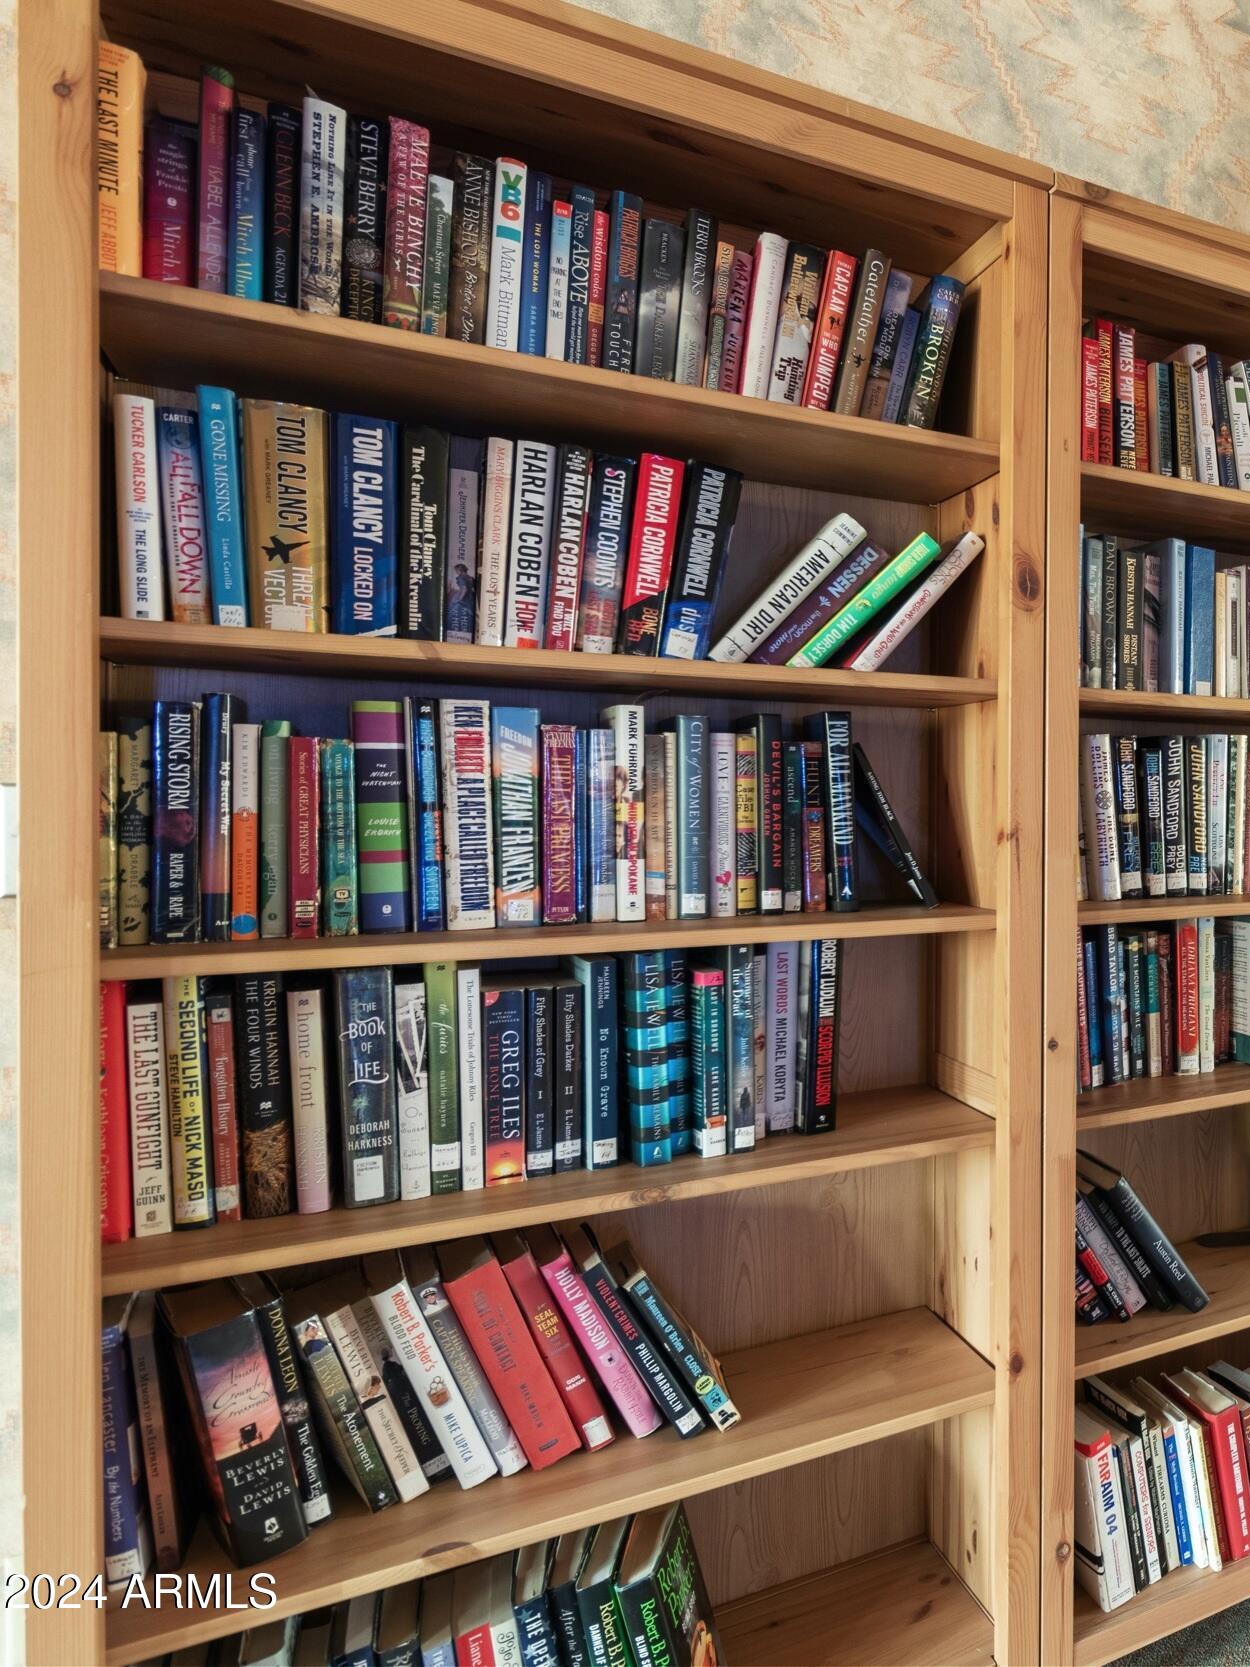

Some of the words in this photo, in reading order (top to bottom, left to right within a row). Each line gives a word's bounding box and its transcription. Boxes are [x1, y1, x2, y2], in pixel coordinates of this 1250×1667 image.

[98, 97, 118, 137] LAST
[98, 139, 119, 195] MINUTE
[311, 111, 322, 182] STEPHEN
[360, 121, 378, 174] STEVE
[208, 165, 224, 209] ISABEL
[410, 137, 430, 213] MAEVE
[465, 160, 484, 204] ANNE
[358, 179, 376, 240] BERRY
[206, 214, 222, 283] ALLENDE
[309, 203, 321, 274] AMBROSE
[406, 213, 425, 289] BINCHY
[461, 204, 481, 267] BISHOP
[274, 247, 286, 289] AGENDA
[501, 246, 515, 285] Mark
[570, 240, 589, 305] ABOVE
[831, 266, 850, 314] CAPLAN
[496, 287, 514, 348] Bittman
[609, 324, 622, 367] TOUCH
[622, 339, 631, 375] FIRE
[916, 322, 943, 400] BROKEN
[1119, 331, 1134, 373] JAMES
[812, 349, 838, 400] JUMPED
[1098, 358, 1112, 403] PATTERSON
[130, 406, 145, 449] TUCKER
[162, 413, 194, 424] CARTER
[1085, 386, 1098, 429] PATTERSON
[1119, 375, 1135, 450] PATTERSON
[210, 420, 227, 460] GONE
[276, 416, 306, 455] TOM
[352, 428, 382, 466] TOM
[132, 452, 146, 502] CARLSON
[213, 464, 231, 522] MISSING
[277, 460, 308, 534] CLANCY
[521, 447, 547, 527] HARLAN
[600, 467, 626, 527] STEPHEN
[645, 463, 674, 524] PATRICIA
[696, 467, 725, 526] PATRICIA
[352, 471, 383, 544] CLANCY
[559, 469, 585, 537] HARLAN
[136, 550, 147, 574] LONG
[177, 526, 202, 594] DOWN
[353, 548, 373, 599] LOCKED
[515, 531, 543, 598] COBEN
[555, 540, 580, 597] COBEN
[594, 529, 619, 589] COONTS
[635, 526, 665, 597] CORNWELL
[683, 527, 716, 597] CORNWELL
[828, 547, 879, 599] DESSEN
[1106, 541, 1117, 572] DAN
[136, 576, 148, 602] SLIDE
[778, 549, 830, 615] AMERICAN
[1106, 576, 1115, 624] BROWN
[353, 601, 373, 620] ON
[515, 600, 538, 634] HOME
[742, 607, 776, 642] DIRT
[810, 631, 841, 662] DORSEY
[167, 713, 191, 760] RISING
[454, 706, 483, 728] KEN
[628, 710, 638, 740] MARK
[690, 721, 702, 754] CITY
[829, 720, 848, 751] FOR
[628, 743, 638, 792] FUHRMAN
[771, 741, 780, 799] DEVIL'S
[1120, 739, 1131, 762] JOHN
[1168, 740, 1181, 776] JOHN
[1190, 745, 1206, 780] JOHN
[167, 762, 190, 810] STORM
[457, 788, 486, 823] PLACE
[690, 776, 702, 829] WOMEN
[1121, 764, 1135, 810] SANDFORD
[1147, 775, 1160, 818] SANDFORD
[1166, 779, 1181, 839] SANDFORD
[1192, 783, 1207, 853] SANDFORD
[459, 824, 488, 860] CALLED
[772, 803, 781, 868] BARGAIN
[1166, 845, 1176, 869] PREY
[502, 827, 535, 896] FRANZEN
[460, 862, 490, 912] FREEDOM
[821, 940, 836, 978] ROBERT
[1108, 927, 1116, 953] BRAD
[644, 964, 658, 995] LISA
[777, 952, 788, 976] LAST
[1108, 954, 1117, 997] TAYLOR
[244, 980, 258, 1001] THE
[263, 980, 276, 1022] KRISTIN
[361, 1001, 376, 1012] THE
[535, 997, 545, 1016] Fifty
[565, 993, 574, 1012] Fifty
[776, 979, 788, 1020] WORDS
[819, 979, 835, 1017] LUDLUM
[132, 1011, 158, 1044] THE
[179, 1001, 198, 1062] SECOND
[246, 1008, 260, 1043] FOUR
[297, 1010, 314, 1058] home
[348, 1021, 386, 1039] BOOK
[536, 1018, 545, 1047] Shades
[565, 1014, 574, 1042] Shades
[600, 1028, 608, 1042] No
[645, 1002, 660, 1050] JEWELL
[775, 1020, 787, 1063] MICHAEL
[135, 1048, 160, 1086] LAST
[249, 1048, 262, 1089] WINDS
[265, 1031, 280, 1086] HANNAH
[354, 1060, 381, 1079] LIFE
[360, 1042, 373, 1054] OF
[501, 1030, 519, 1089] GREG
[565, 1043, 574, 1072] Darker
[600, 1048, 610, 1082] Known
[169, 1054, 178, 1086] STEVE
[182, 1065, 199, 1099] LIFE
[299, 1066, 316, 1110] front
[774, 1065, 786, 1103] KORYTA
[170, 1088, 181, 1137] HAMILTON
[502, 1095, 520, 1139] ILES
[600, 1085, 610, 1118] Grave
[136, 1088, 162, 1170] GUNFIGHT
[185, 1115, 201, 1153] NICK
[347, 1136, 392, 1151] HARKNESS
[349, 1120, 390, 1135] DEBORAH
[136, 1195, 165, 1206] GUINN
[138, 1186, 162, 1196] JEFF
[1154, 1240, 1171, 1264] Austin
[1168, 1260, 1186, 1281] Reed
[536, 1308, 553, 1324] SEAL
[537, 1316, 559, 1332] TEAM
[555, 1268, 583, 1301] HOLLY
[574, 1300, 609, 1350] MADISON
[595, 1279, 618, 1312] VIOLENT
[614, 1310, 638, 1341] CRIMES
[645, 1295, 668, 1329] Maureen
[269, 1308, 289, 1356] DONNA
[280, 1356, 298, 1393] LEON
[413, 1335, 435, 1373] Parker's
[545, 1327, 559, 1338] SIX
[339, 1335, 362, 1378] LEWIS
[635, 1343, 659, 1376] PHILLIP
[654, 1375, 683, 1413] MARGOLIN
[298, 1423, 309, 1445] The
[344, 1412, 375, 1473] Atonement
[444, 1413, 460, 1436] MIKE
[454, 1433, 473, 1464] LUPICA
[225, 1447, 286, 1480] BEVERLY
[232, 1459, 285, 1487] LEWIS
[302, 1445, 318, 1485] Golden
[239, 1487, 291, 1516] LEWIS
[243, 1482, 283, 1503] DAVID
[524, 1613, 541, 1638] THE
[599, 1600, 615, 1648] Robert
[640, 1599, 660, 1642] Robert
